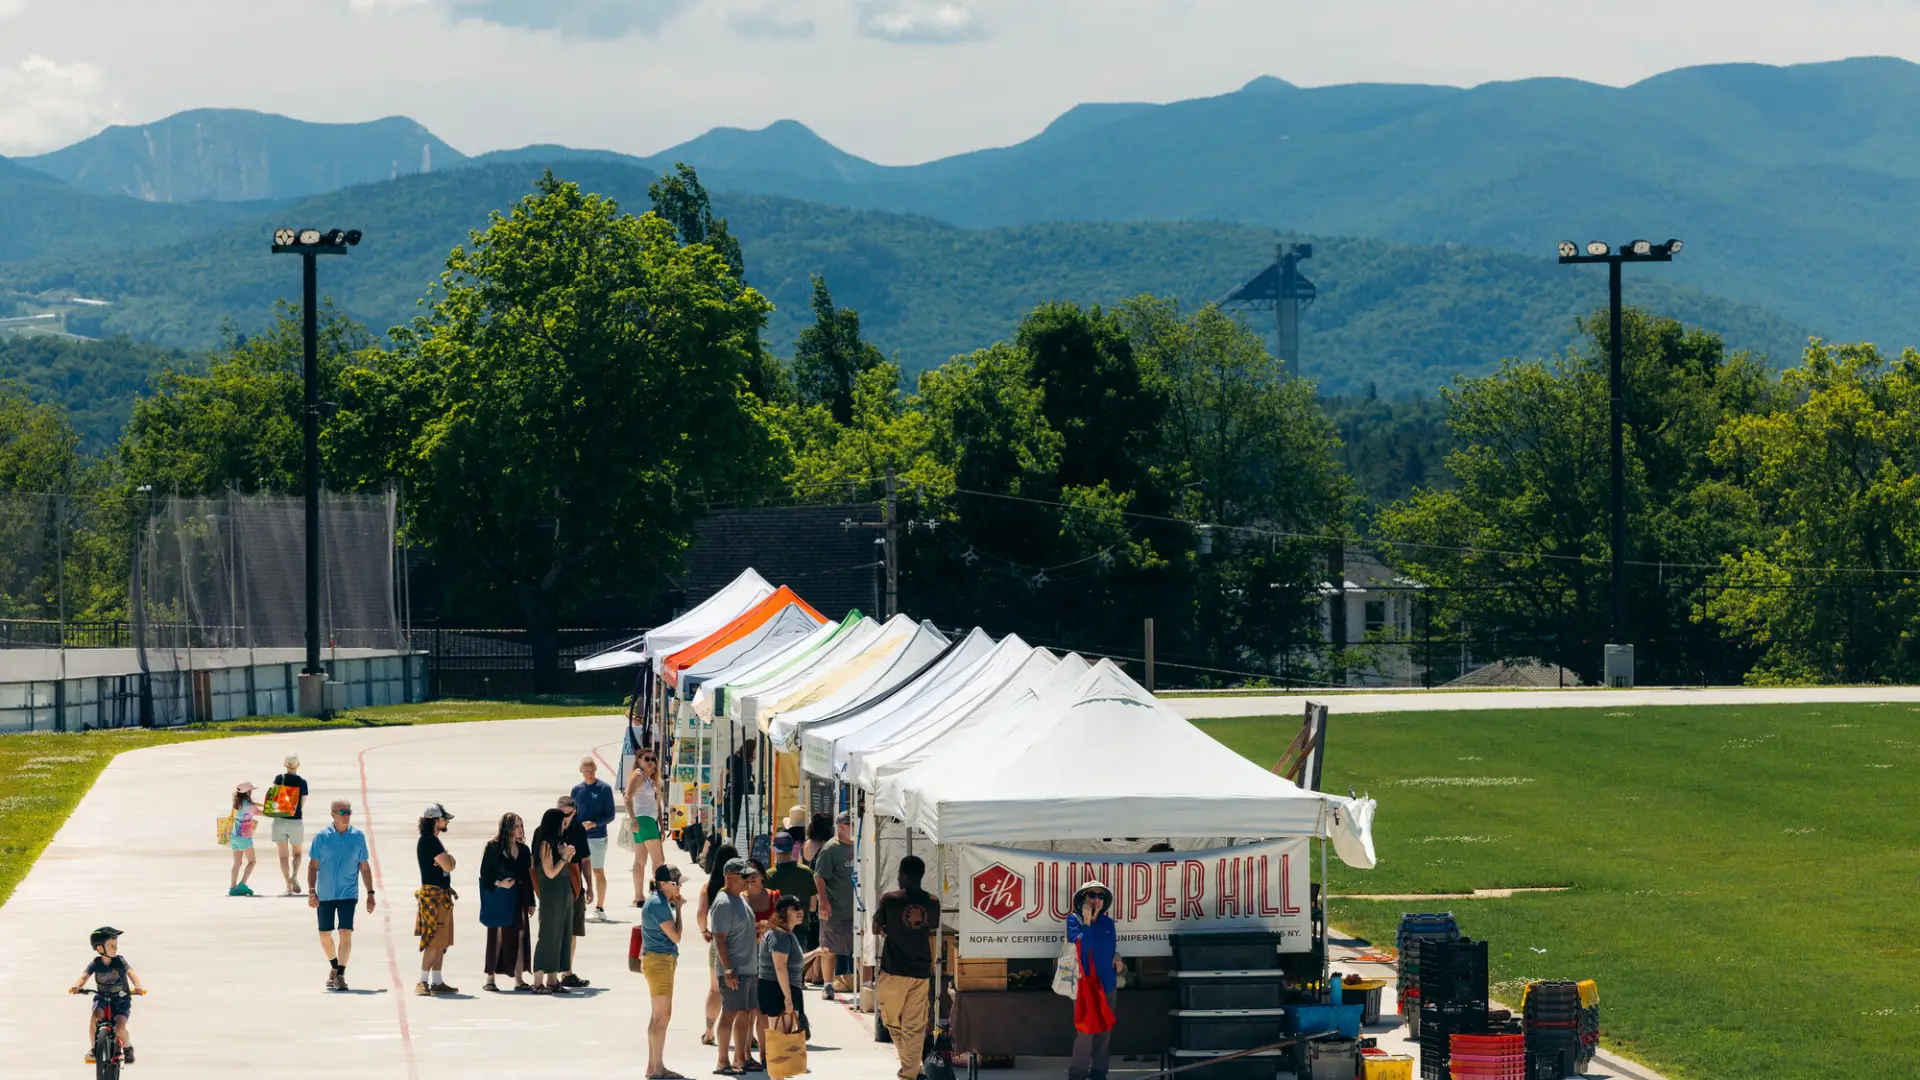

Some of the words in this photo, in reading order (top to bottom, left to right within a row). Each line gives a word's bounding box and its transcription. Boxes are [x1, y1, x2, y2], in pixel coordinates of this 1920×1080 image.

[977, 872, 1017, 913] jh
[1215, 853, 1301, 919] HILL
[969, 935, 1009, 943] NOFA-NY
[1011, 935, 1058, 943] CERTIFIED
[1287, 929, 1302, 937] NY.
